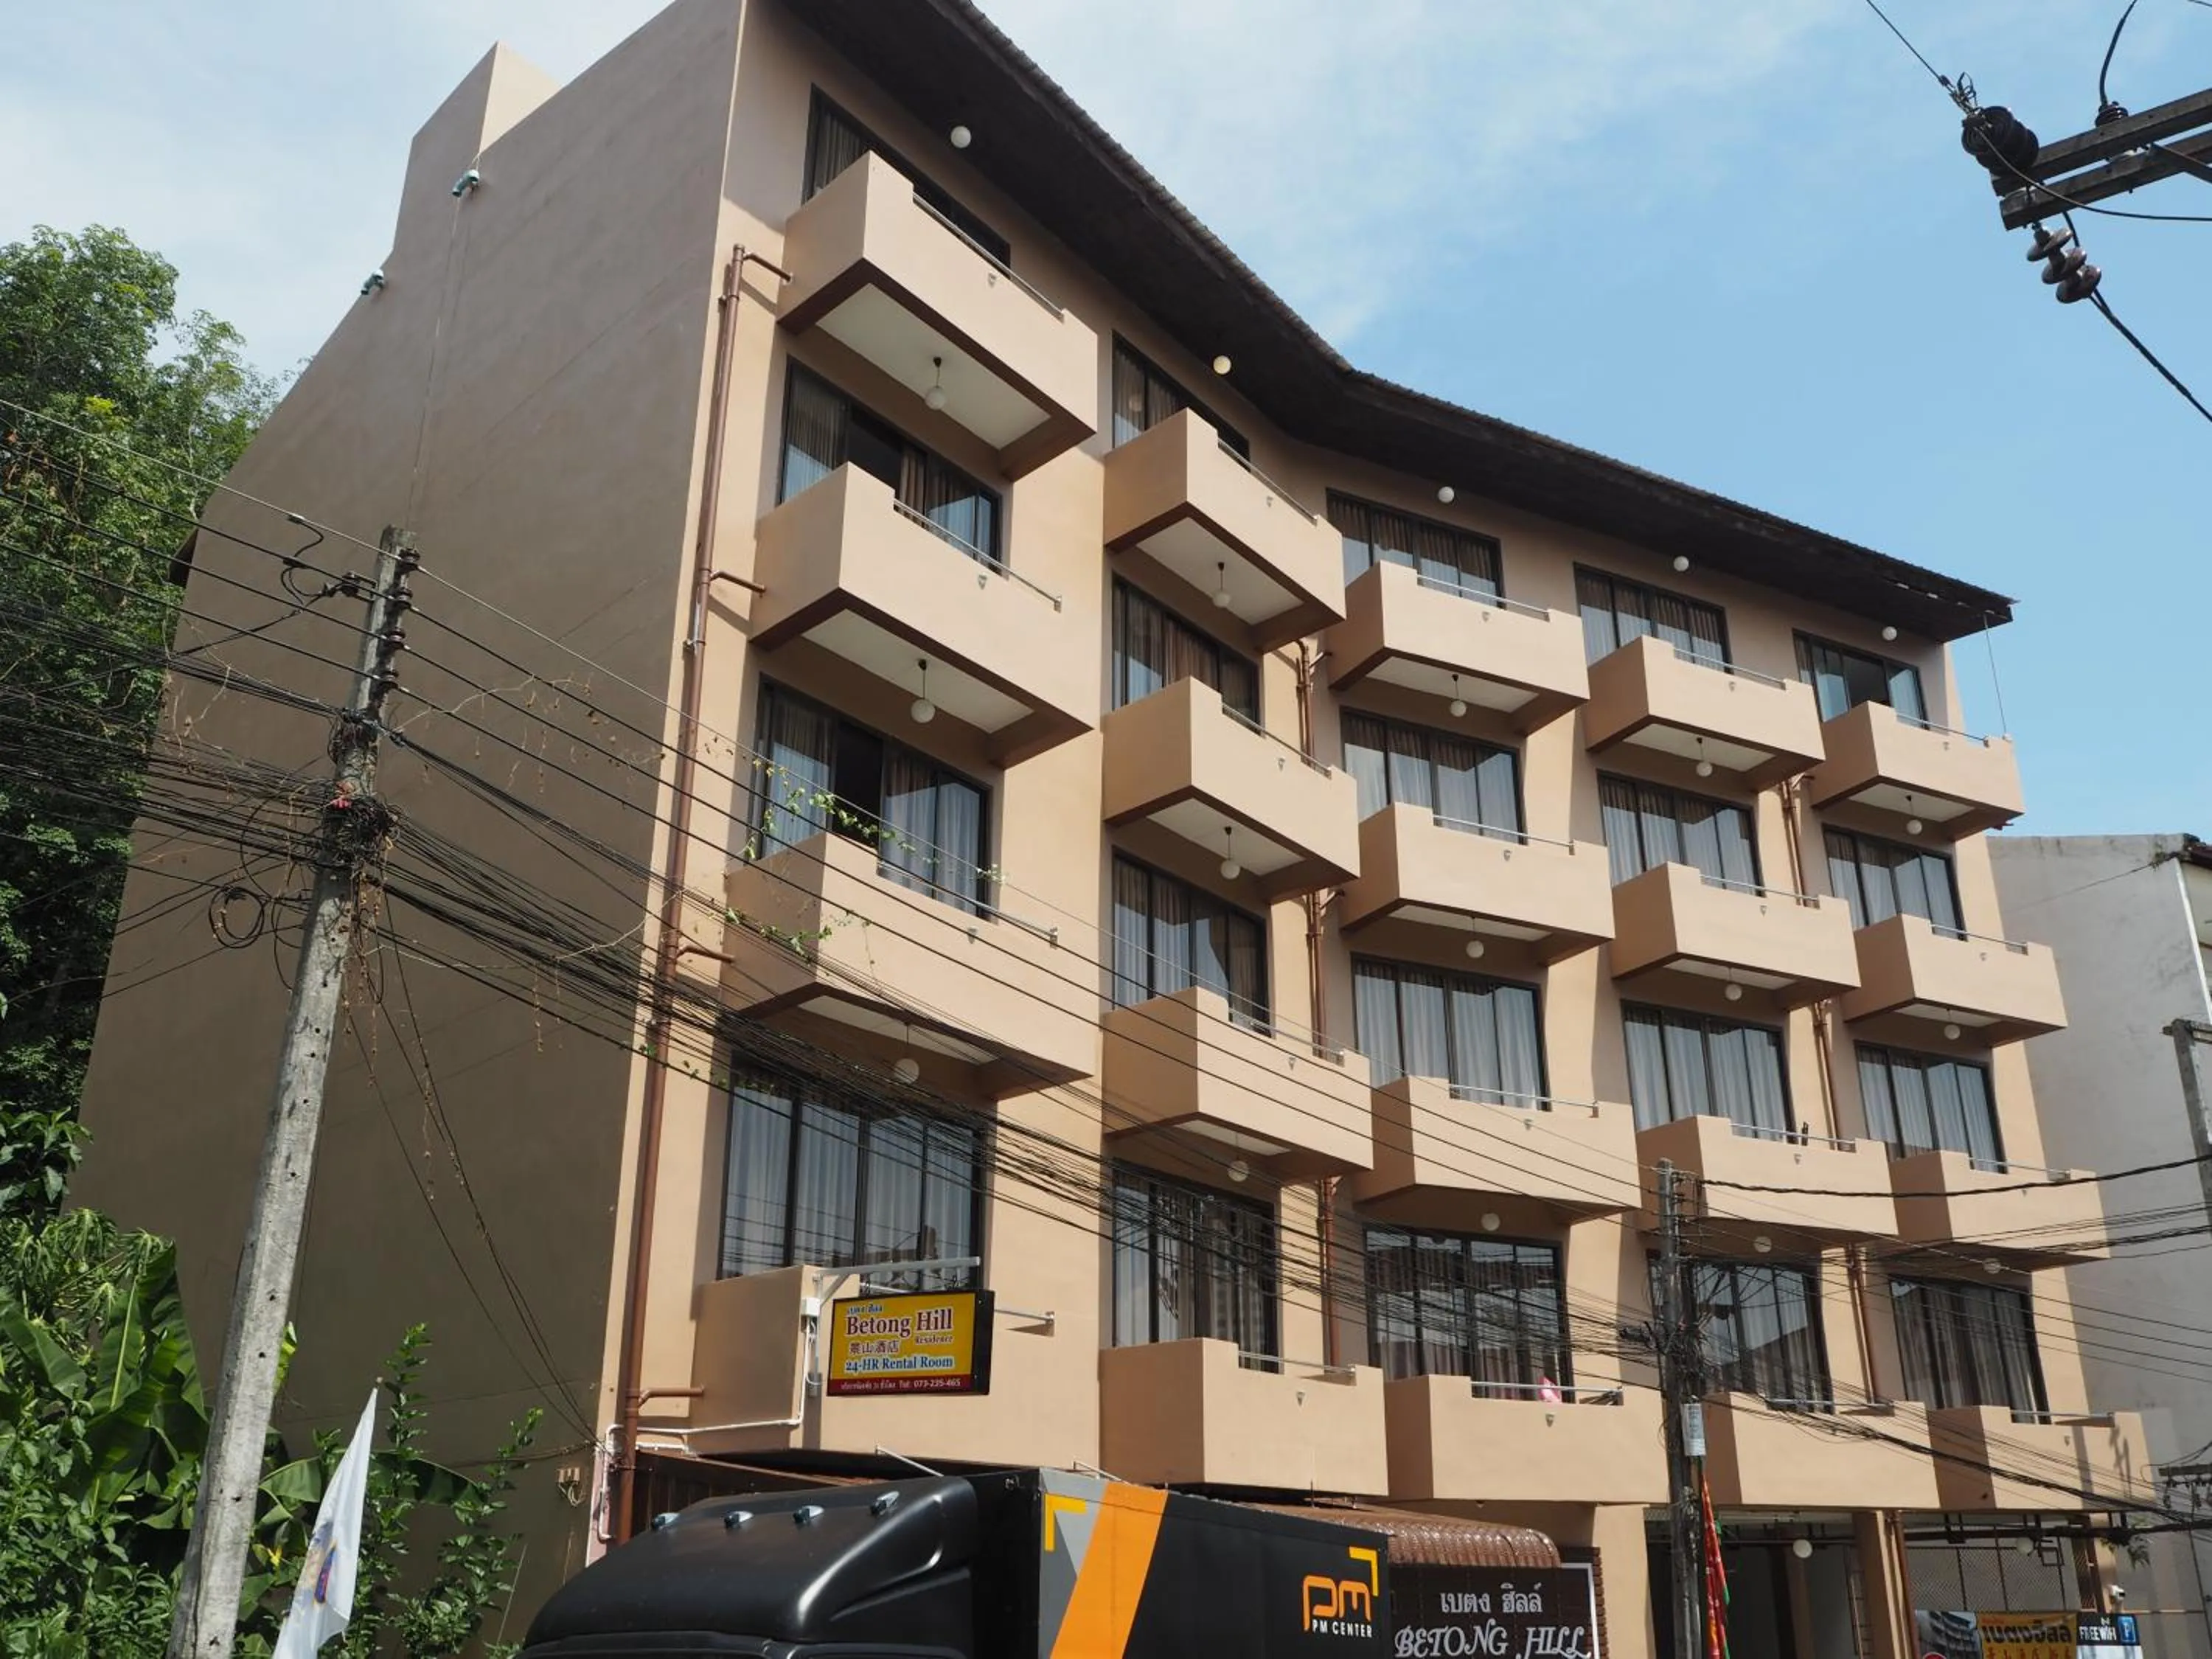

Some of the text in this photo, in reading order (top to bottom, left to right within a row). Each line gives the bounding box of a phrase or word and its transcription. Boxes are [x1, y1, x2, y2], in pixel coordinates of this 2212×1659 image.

[846, 1308, 953, 1338] Betong Hill
[846, 1356, 953, 1373] 24-HR Rental Room
[1440, 1582, 1543, 1613] เบตง ฮิลล์
[1312, 1619, 1372, 1638] PM CENTER
[1394, 1618, 1592, 1659] BETONG HILL
